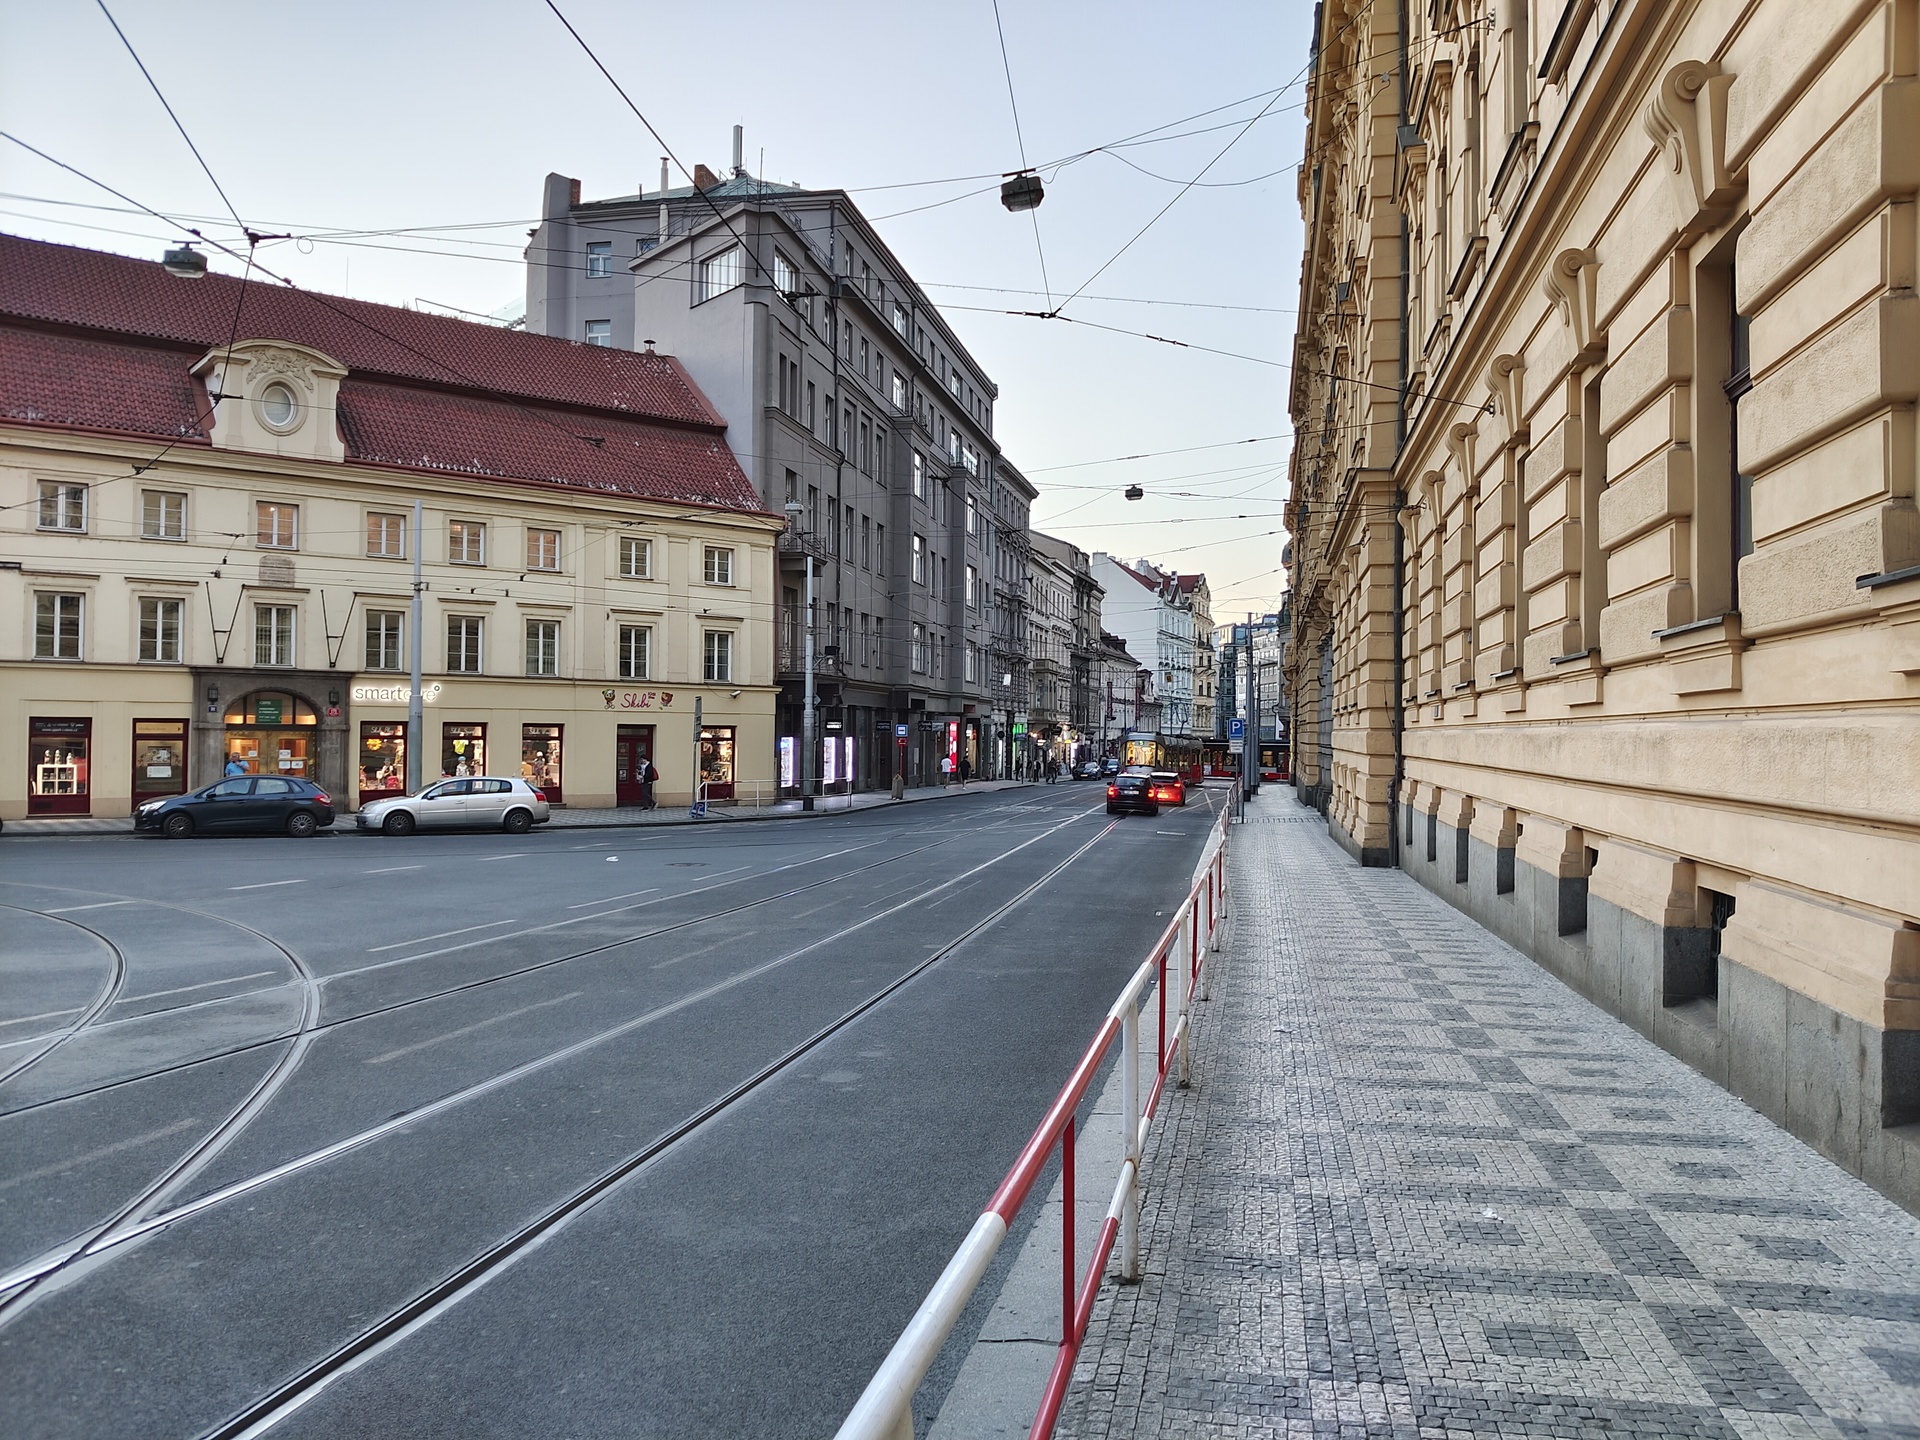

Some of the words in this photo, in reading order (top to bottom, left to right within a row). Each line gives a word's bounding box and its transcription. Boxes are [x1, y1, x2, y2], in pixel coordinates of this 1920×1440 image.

[355, 686, 436, 701] smartcre
[620, 692, 651, 708] Skibi
[1231, 721, 1241, 733] P
